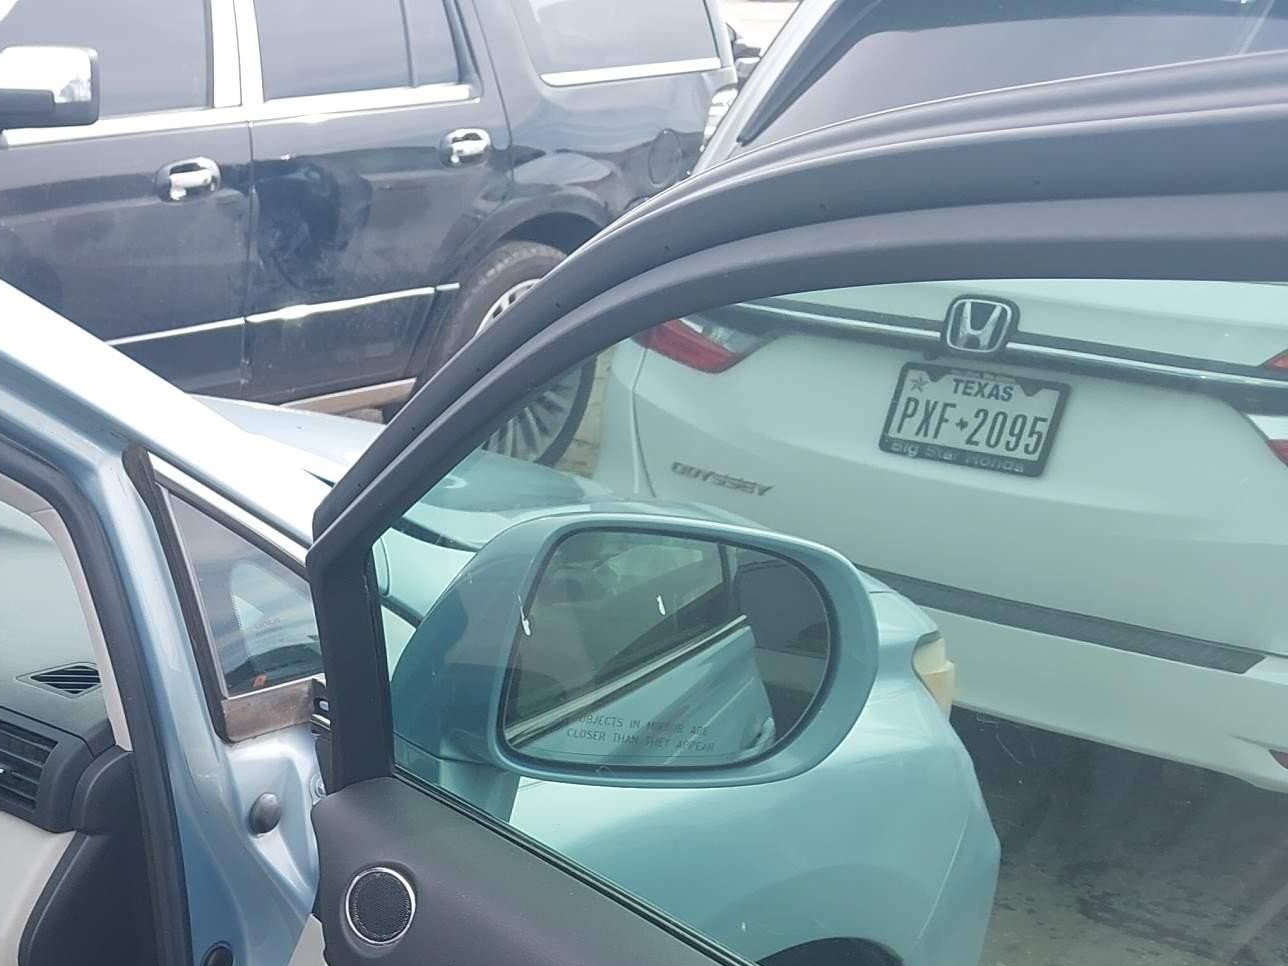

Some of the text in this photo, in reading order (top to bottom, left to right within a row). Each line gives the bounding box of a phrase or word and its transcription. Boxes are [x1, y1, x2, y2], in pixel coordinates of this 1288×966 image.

[952, 378, 1015, 402] TEXAS
[671, 461, 774, 497] ODYSSEY
[577, 714, 624, 728] OBJECTS
[629, 719, 641, 729] IN
[690, 726, 710, 736] ARE
[567, 728, 606, 741] CLOSER
[613, 733, 638, 745] THAN
[647, 736, 668, 748] THEY
